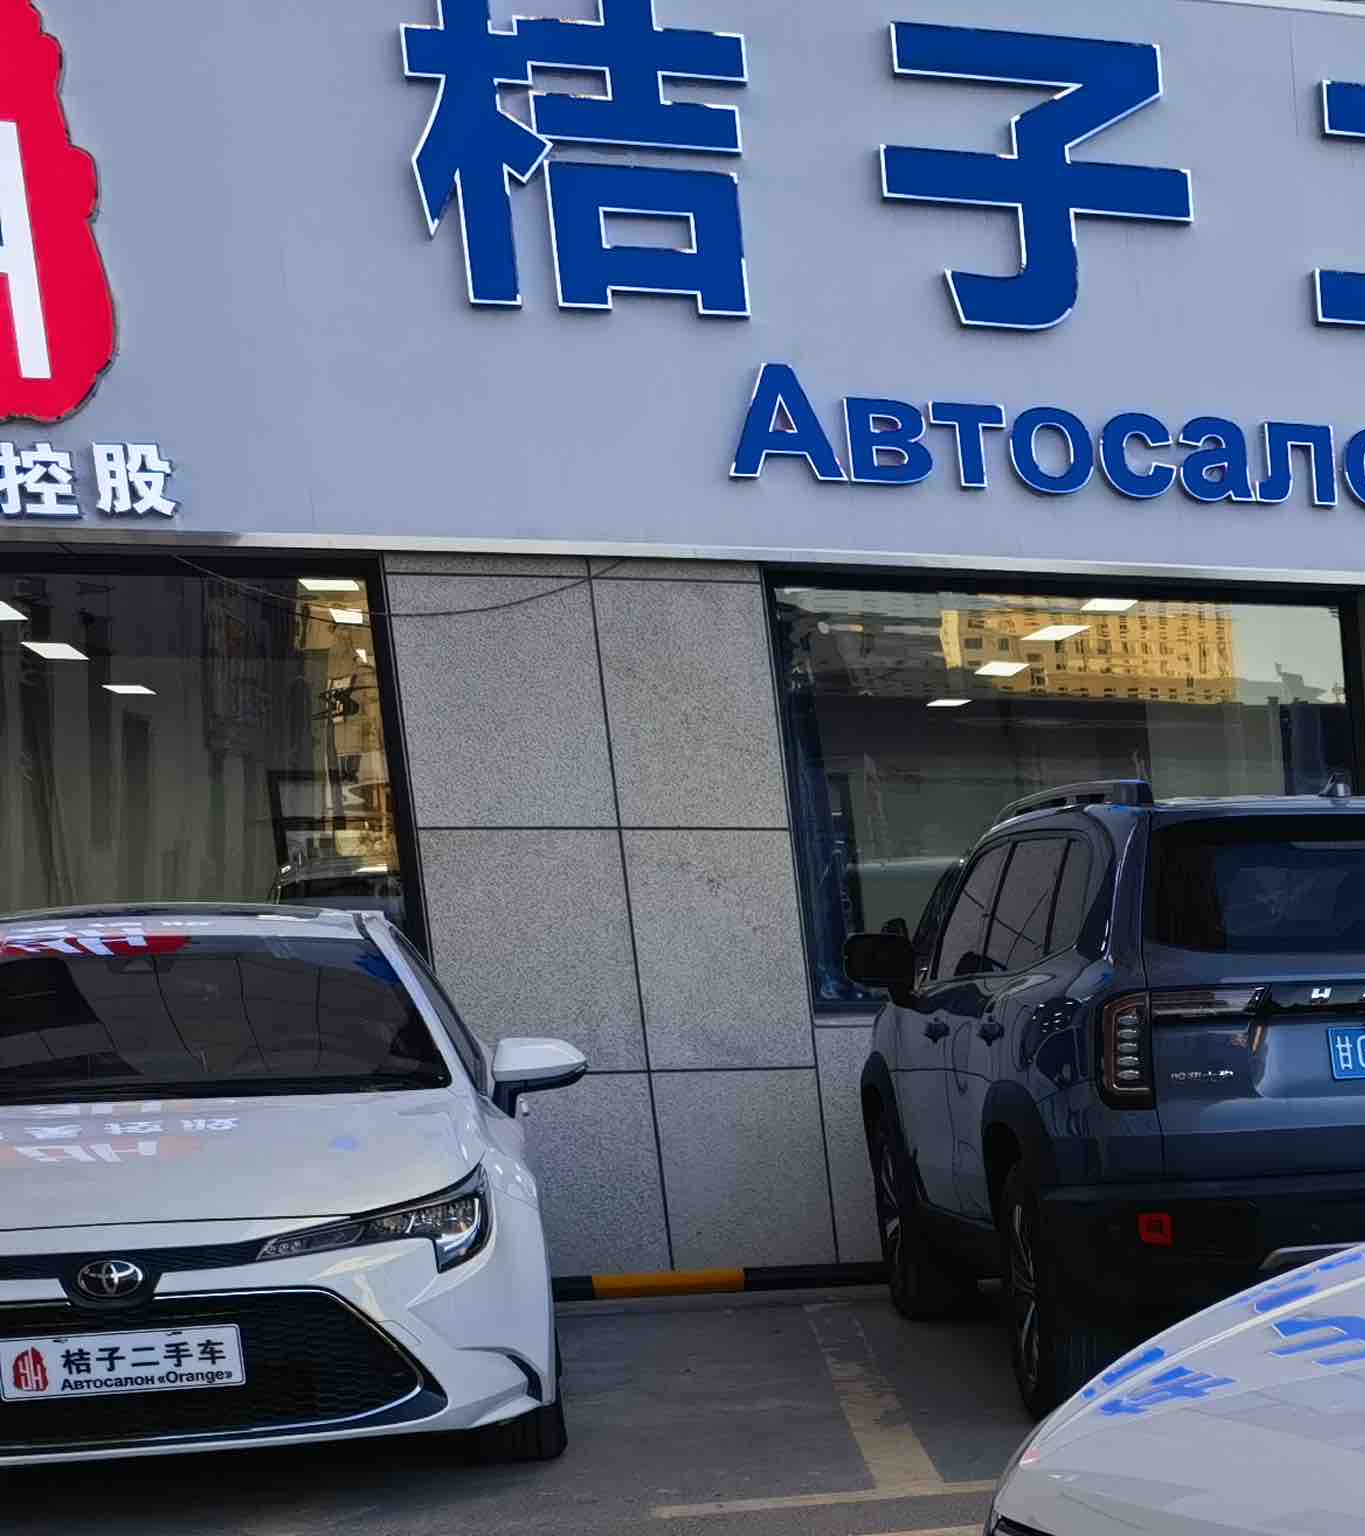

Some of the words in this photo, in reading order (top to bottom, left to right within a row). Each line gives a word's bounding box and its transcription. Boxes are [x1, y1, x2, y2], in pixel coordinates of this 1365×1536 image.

[60, 1338, 227, 1377] 桔子二手车
[60, 1373, 155, 1391] Автосалон
